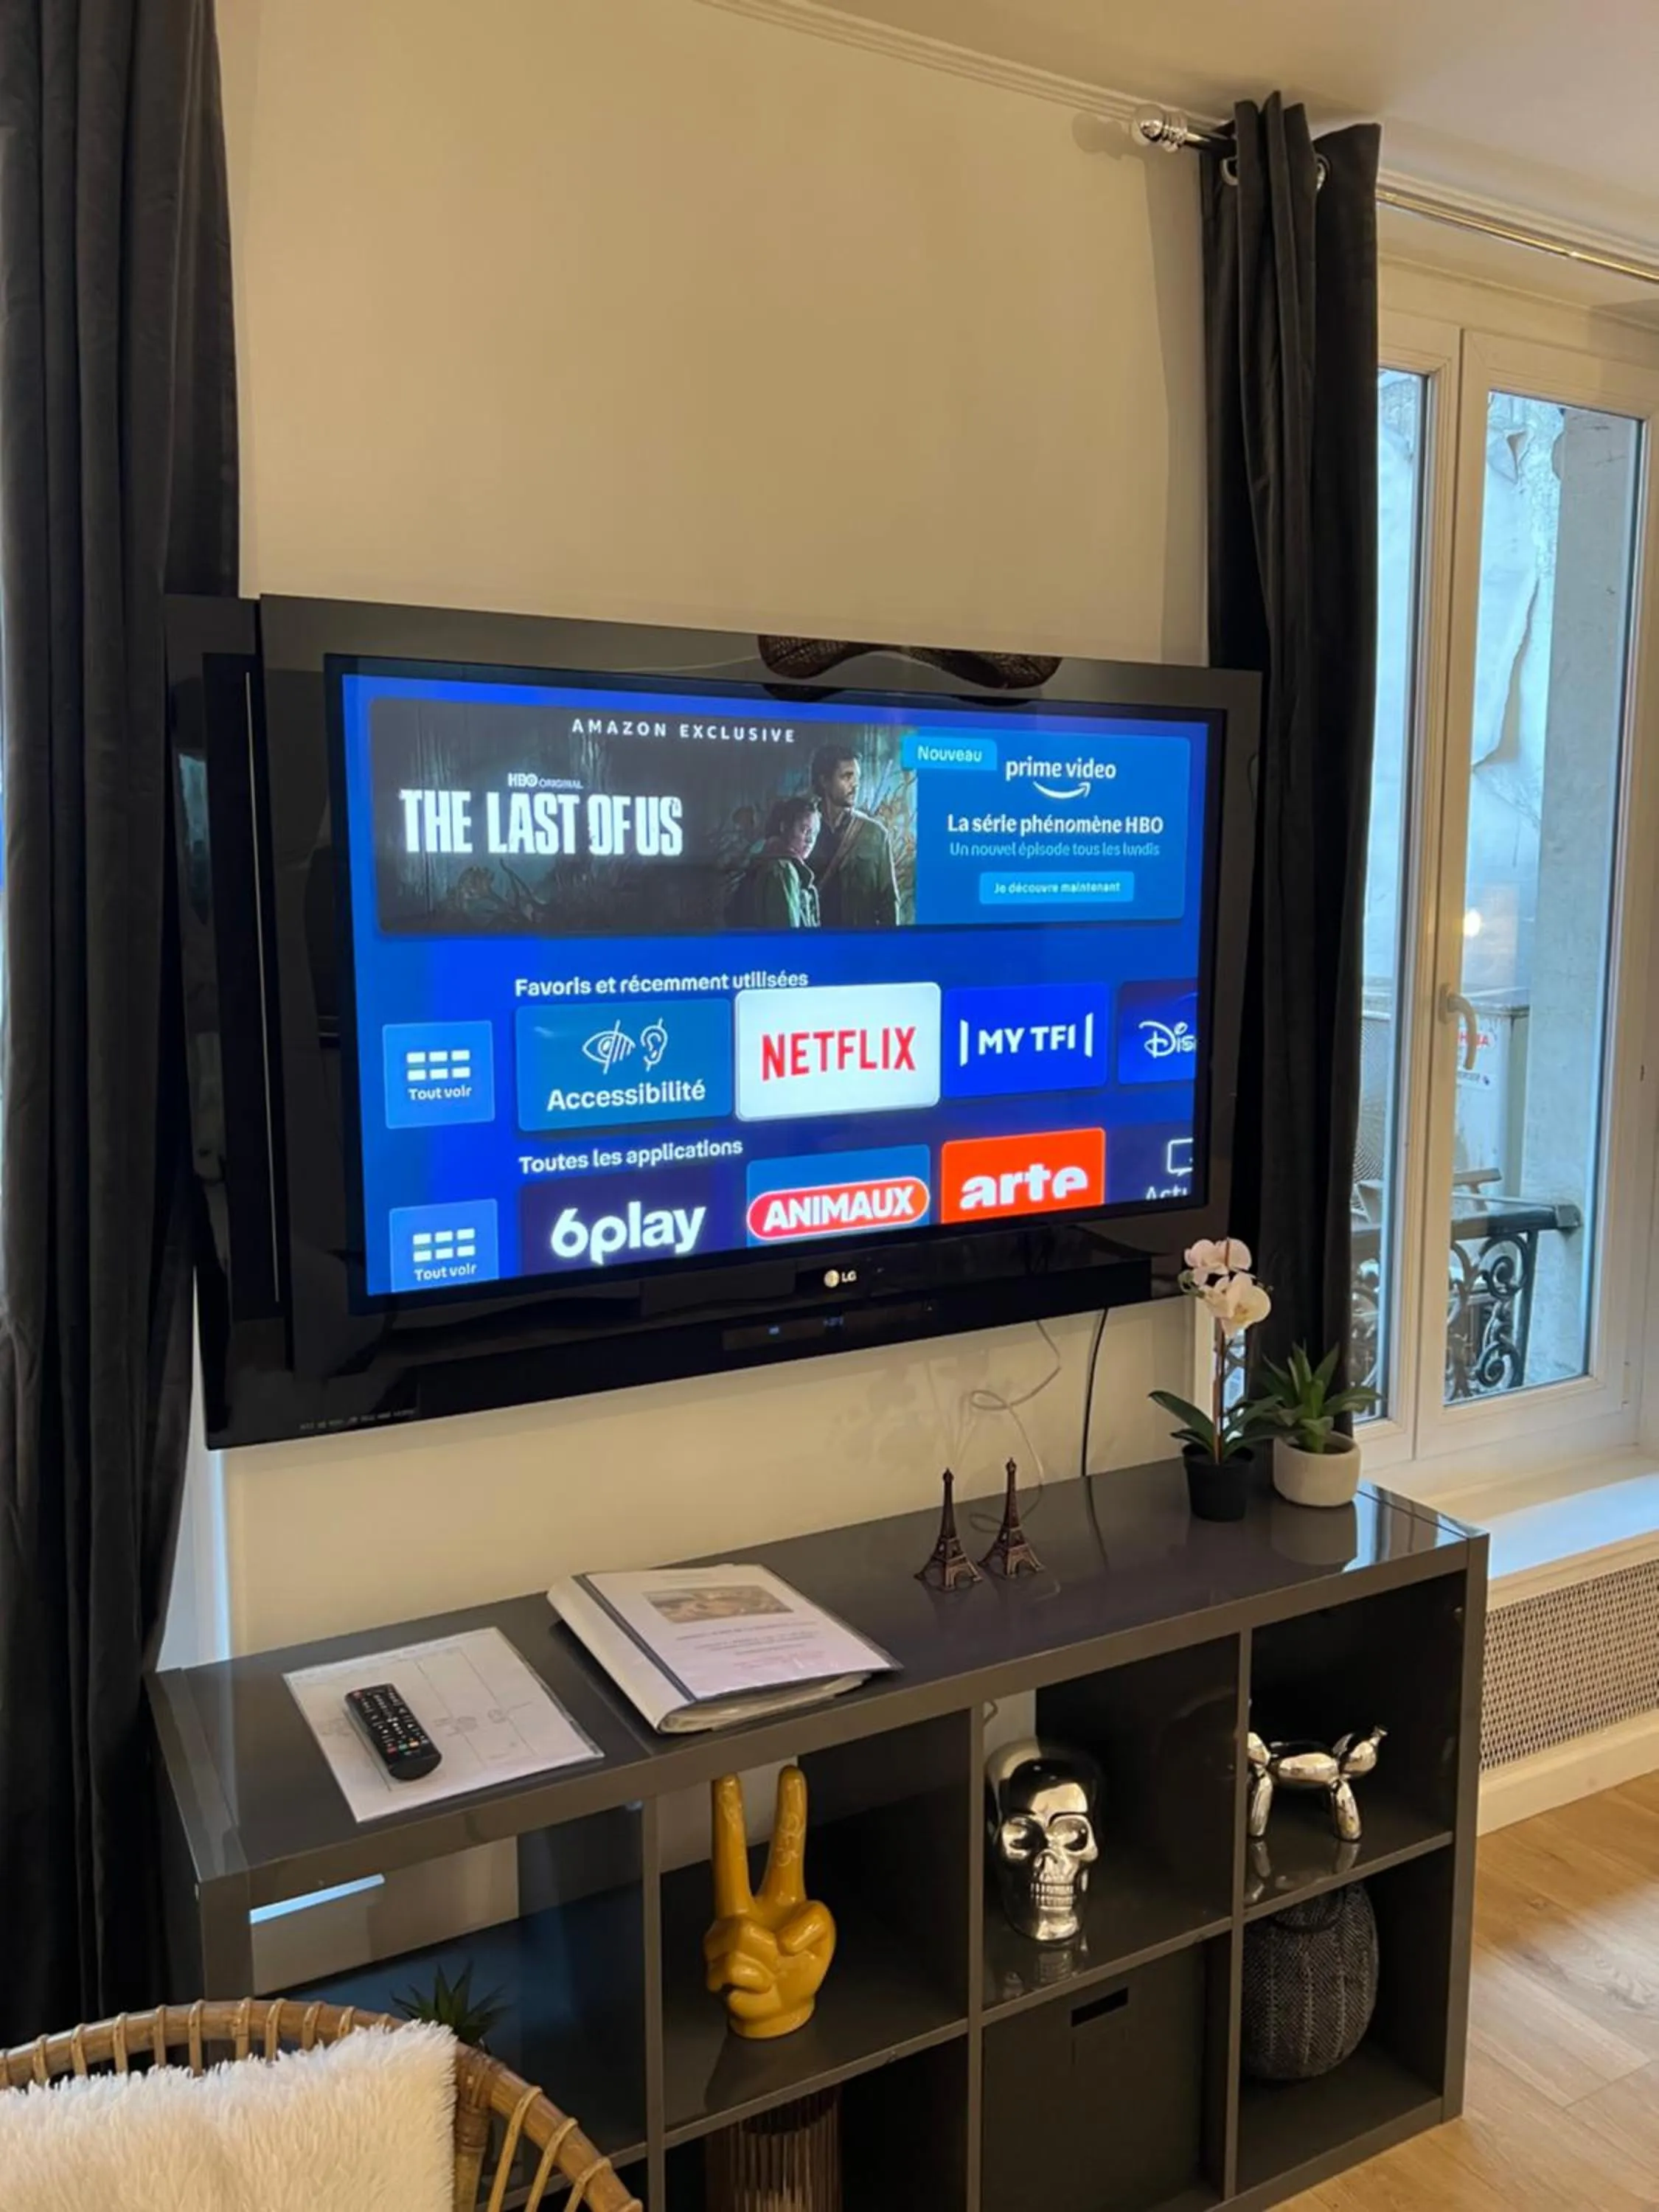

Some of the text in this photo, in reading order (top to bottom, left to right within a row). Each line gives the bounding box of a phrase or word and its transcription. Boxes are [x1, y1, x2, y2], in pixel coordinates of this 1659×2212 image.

[571, 718, 794, 743] AMAZON EXCLUSIVE
[917, 745, 982, 762] Nouveau
[507, 773, 539, 788] HBO
[1005, 756, 1116, 782] prime video
[399, 789, 683, 856] THE LAST OF US
[947, 813, 1164, 837] La série phénomène HBO
[950, 841, 1160, 859] Un nouvel épisode tous les lundis
[994, 882, 1121, 894] Je découvre maintenant
[515, 970, 808, 997] Favoris et récemment utilisées
[978, 1027, 1025, 1055] MY
[1138, 1020, 1197, 1058] Dis
[762, 1026, 917, 1082] NETFLIX
[408, 1085, 472, 1101] Tout voir
[547, 1079, 706, 1111] Accessibilité
[518, 1139, 743, 1174] Toutes les applications
[960, 1163, 1089, 1210] arte
[762, 1185, 915, 1232] ANIMAUX
[549, 1200, 707, 1266] 6play
[414, 1262, 476, 1281] Tout voir
[841, 1270, 857, 1283] LG
